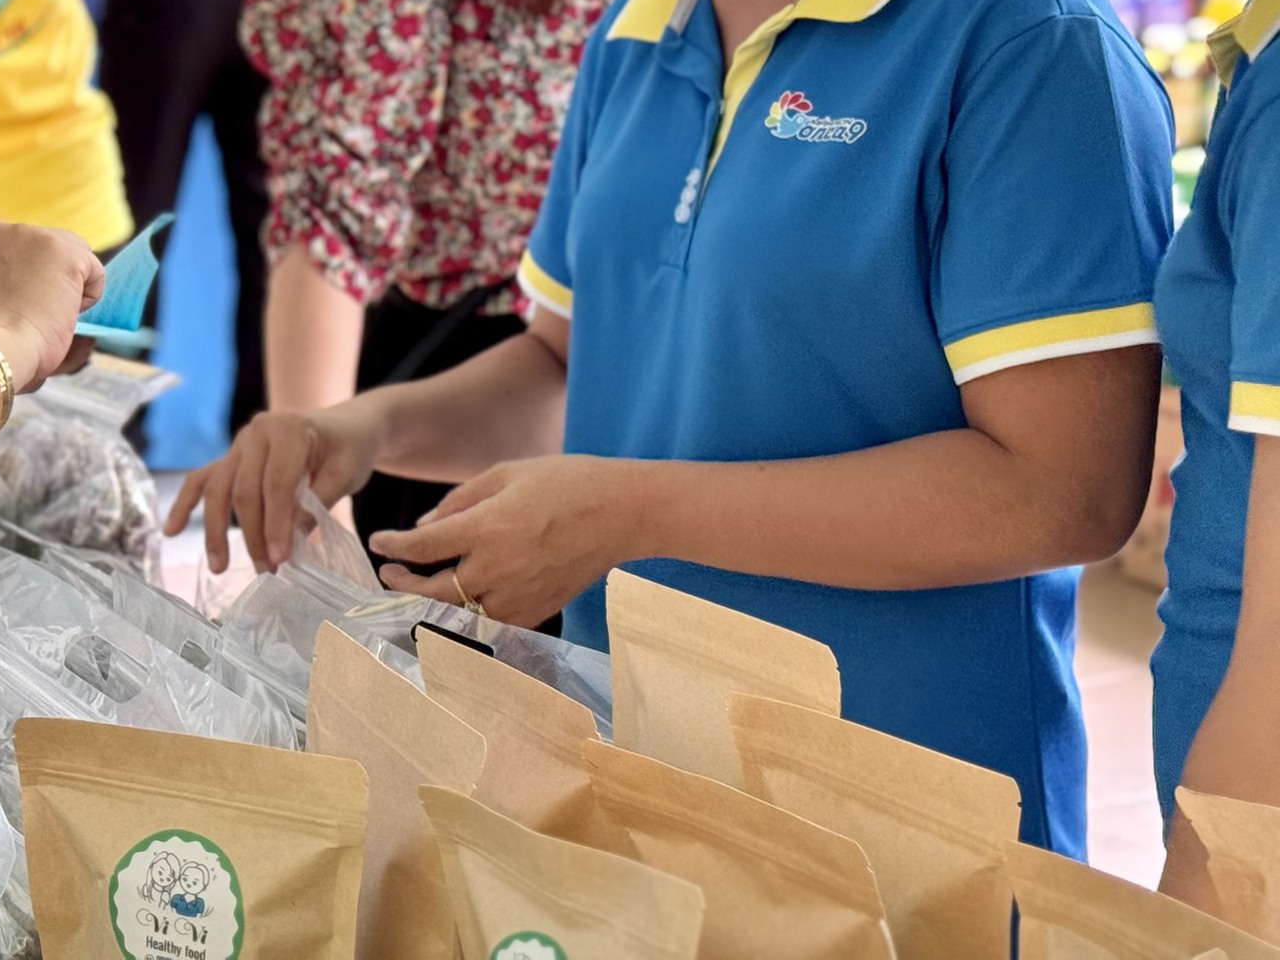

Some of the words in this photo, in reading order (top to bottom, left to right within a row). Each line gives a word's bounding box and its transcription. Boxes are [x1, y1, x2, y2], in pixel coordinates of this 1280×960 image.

[136, 908, 169, 935] Vi
[174, 917, 208, 945] Vi
[146, 935, 182, 957] Healthy
[184, 945, 206, 960] food
